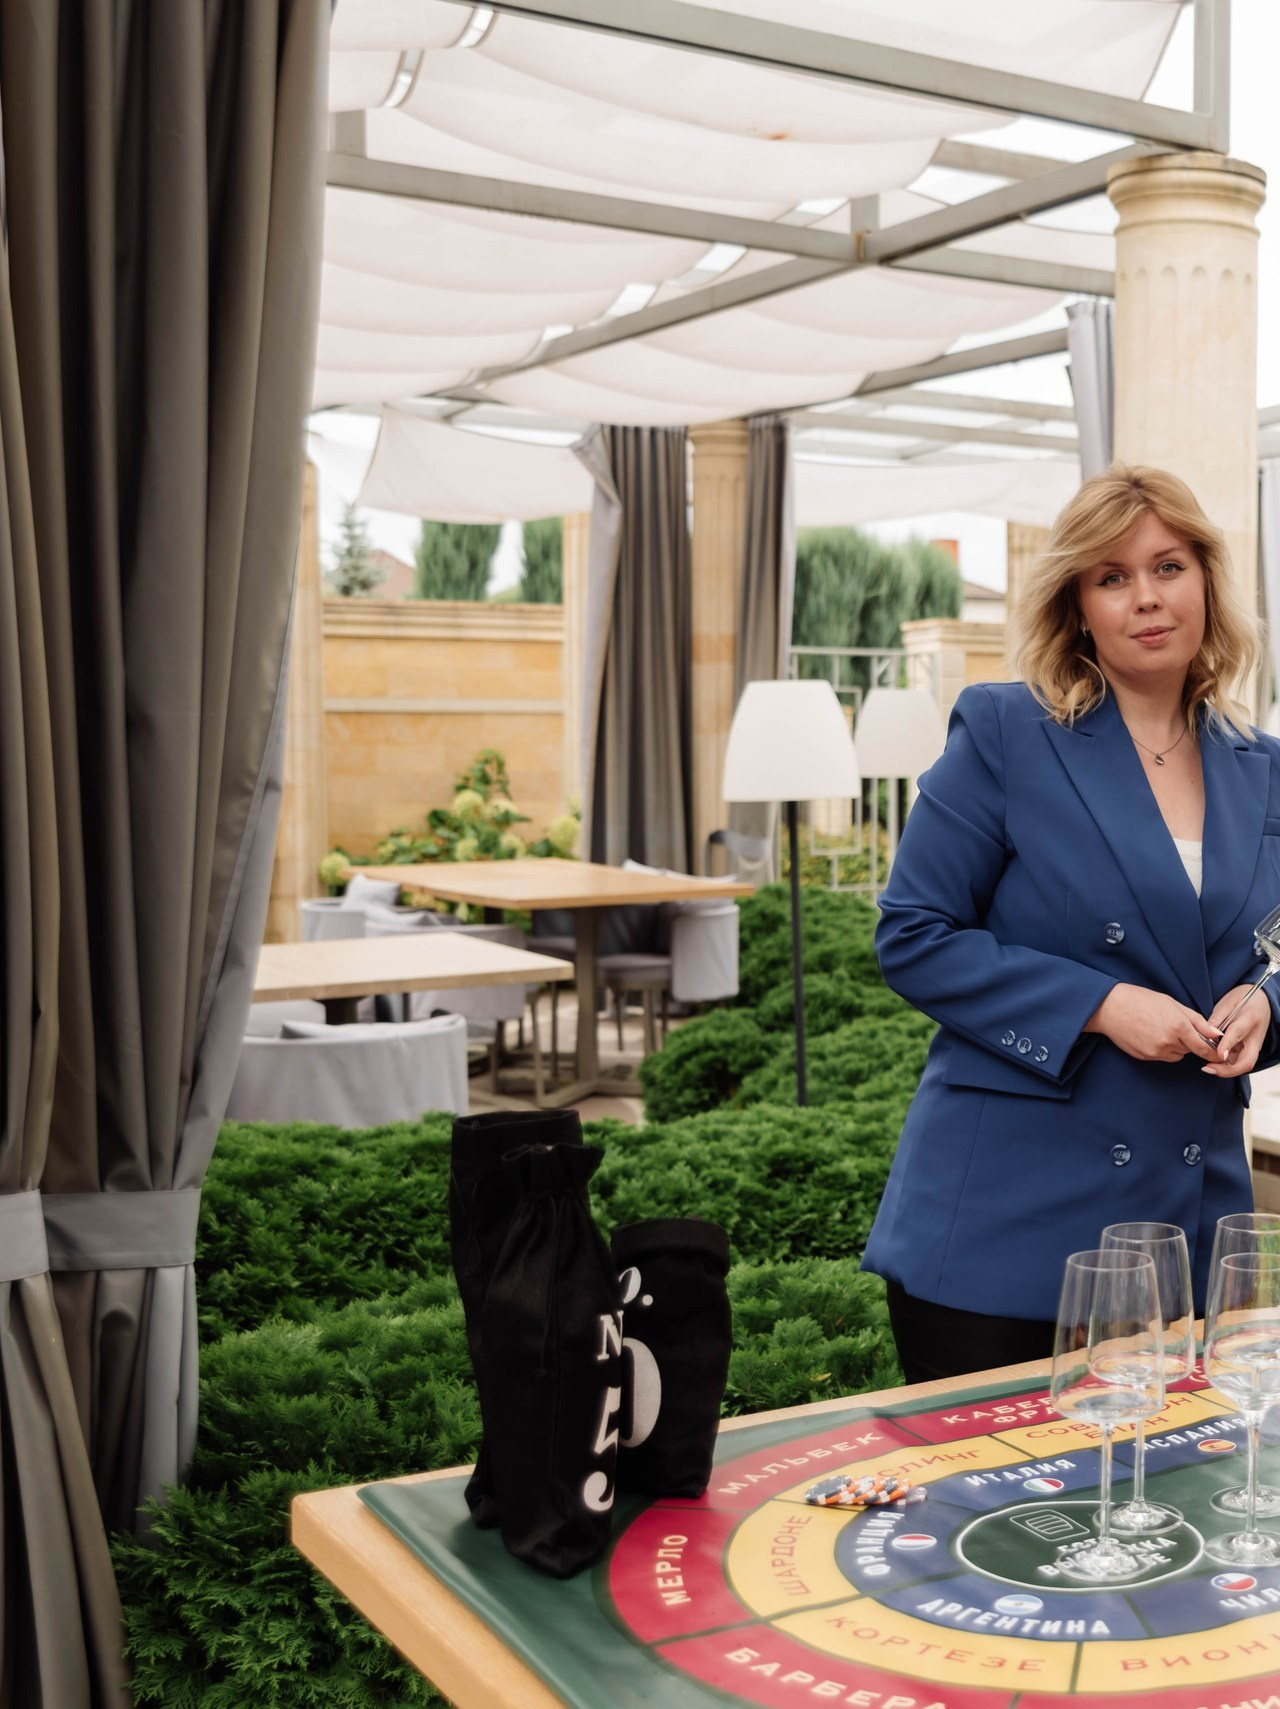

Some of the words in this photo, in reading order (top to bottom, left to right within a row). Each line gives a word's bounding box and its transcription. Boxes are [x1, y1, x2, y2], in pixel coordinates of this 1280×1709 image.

[993, 1406, 1057, 1423] ФРА
[1133, 1417, 1248, 1451] ИСПАНИЯ
[718, 1431, 884, 1495] МАЛЬБЕК
[876, 1449, 980, 1477] СЛИНГ
[963, 1458, 1078, 1487] ИТАЛИЯ
[771, 1515, 814, 1597] ШАРДОНЕ
[854, 1510, 906, 1576] ФРАНЦИЯ
[655, 1534, 693, 1607] МЕРЛО
[915, 1598, 1112, 1636] АРГЕНТИНА
[824, 1615, 1047, 1673] КОРТЕЗЕ
